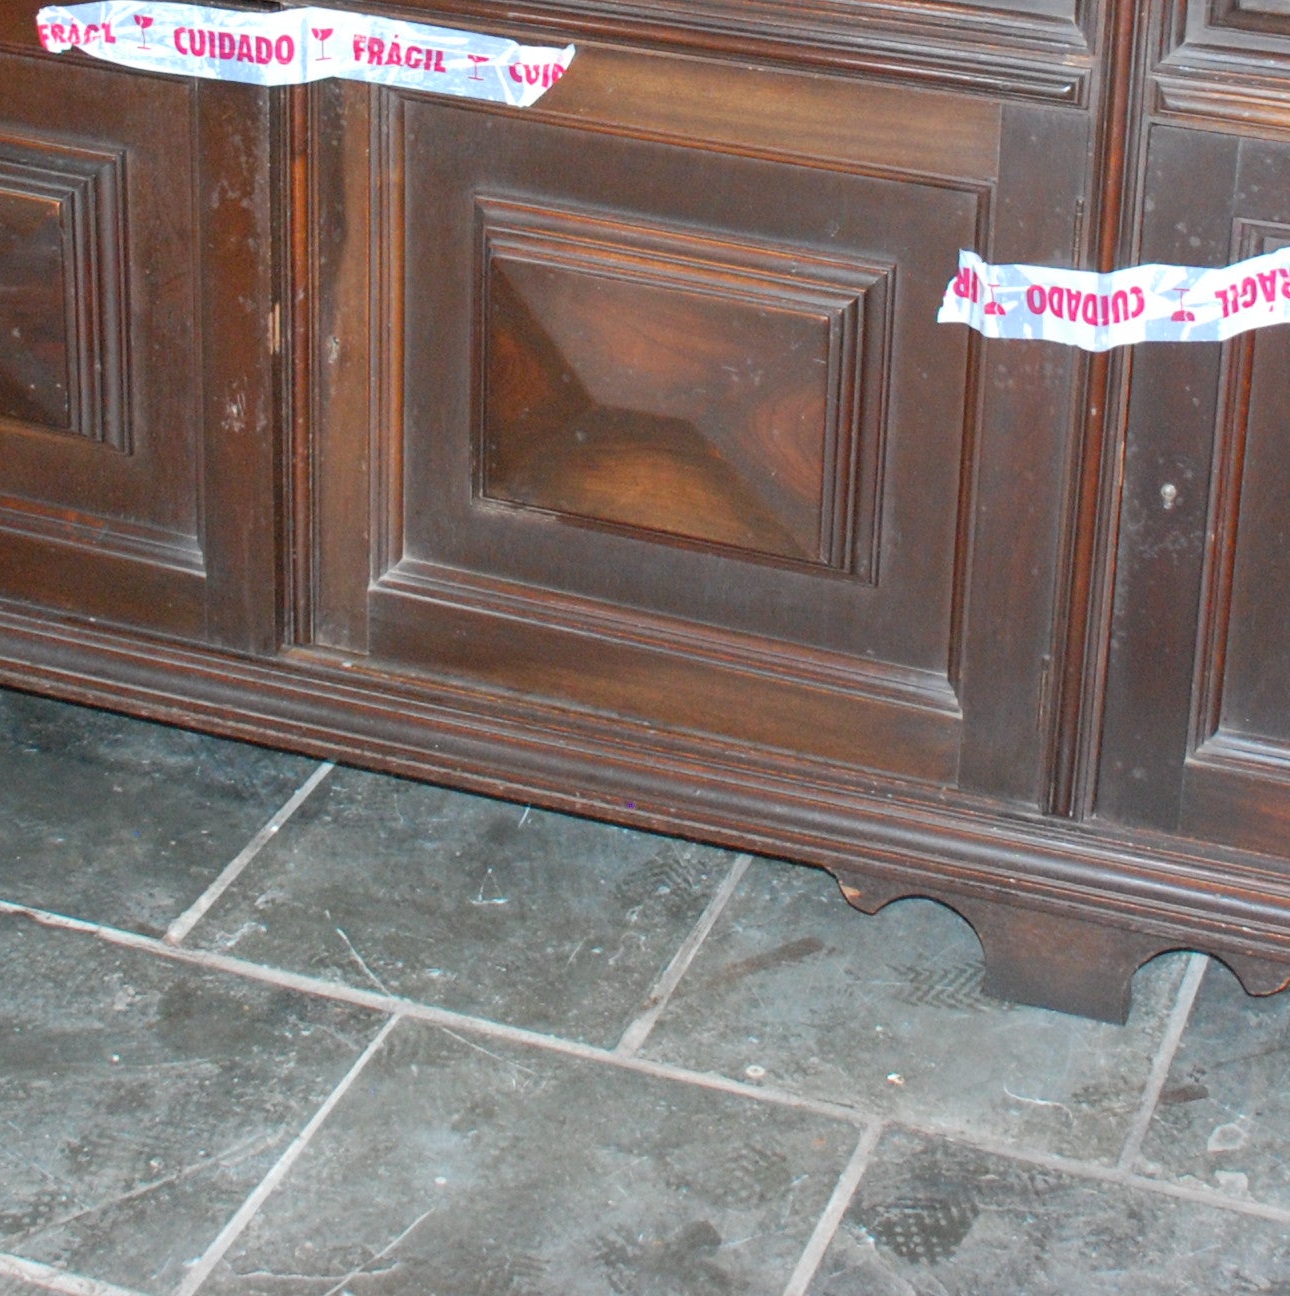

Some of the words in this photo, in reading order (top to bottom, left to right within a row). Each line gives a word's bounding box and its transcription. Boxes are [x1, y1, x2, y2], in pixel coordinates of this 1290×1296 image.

[173, 26, 295, 65] CUIDADO
[352, 34, 447, 73] FRÁGIL
[1026, 284, 1146, 327] CUIDADO
